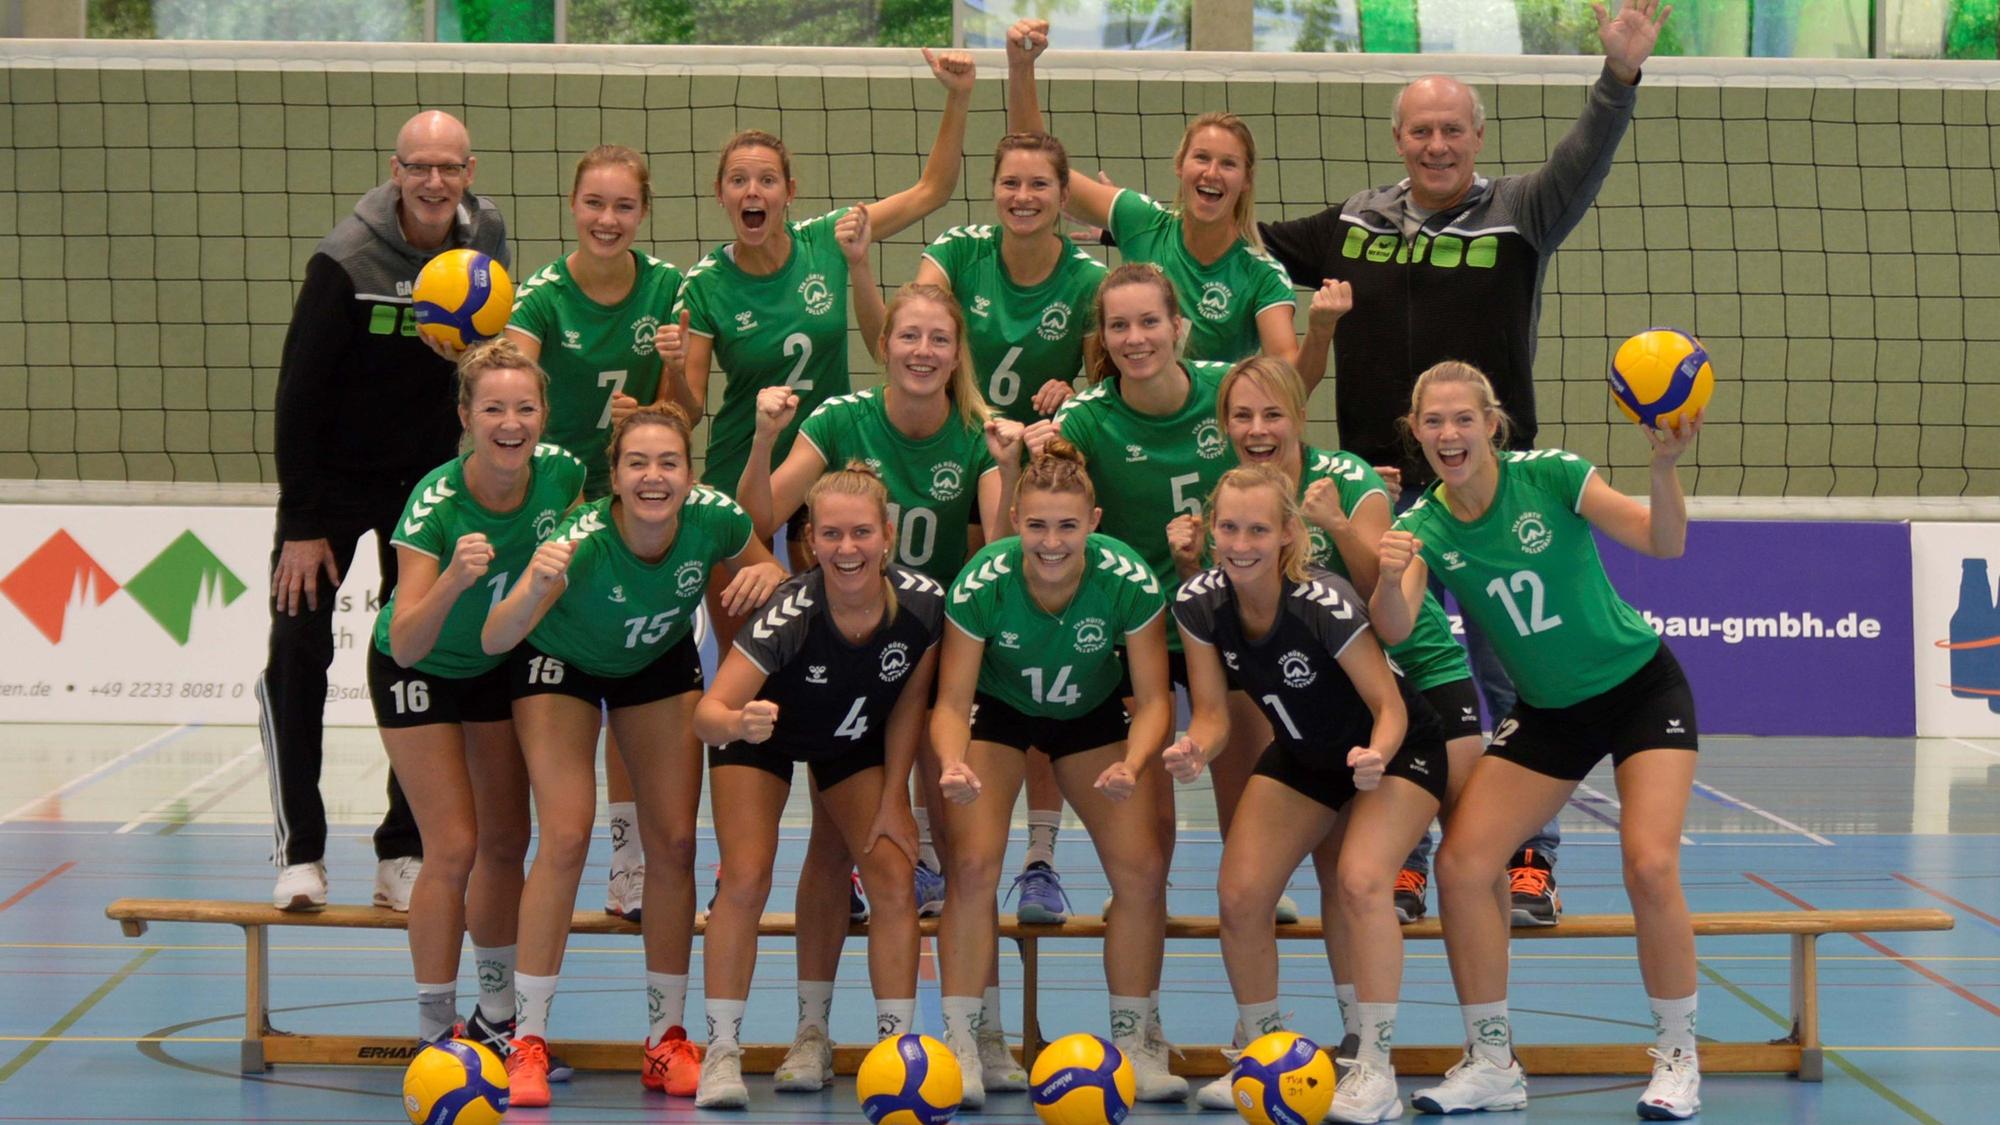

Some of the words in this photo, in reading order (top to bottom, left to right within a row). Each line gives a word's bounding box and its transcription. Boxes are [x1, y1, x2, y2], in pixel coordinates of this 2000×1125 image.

[783, 332, 813, 391] 2
[988, 346, 1023, 406] 6
[596, 369, 628, 430] 7
[1170, 471, 1202, 517] 5
[1486, 569, 1562, 637] 12
[624, 606, 680, 649] 15
[1638, 610, 1882, 644] bau-gmbh.de
[0, 680, 51, 697] en.de
[88, 681, 122, 697] +49
[128, 682, 173, 698] 2233
[180, 683, 225, 698] 8081
[231, 683, 244, 698] 0
[527, 655, 566, 686] 15
[1021, 664, 1082, 707] 14
[389, 679, 430, 715] 16
[833, 696, 868, 741] 4
[1262, 694, 1303, 740] 1
